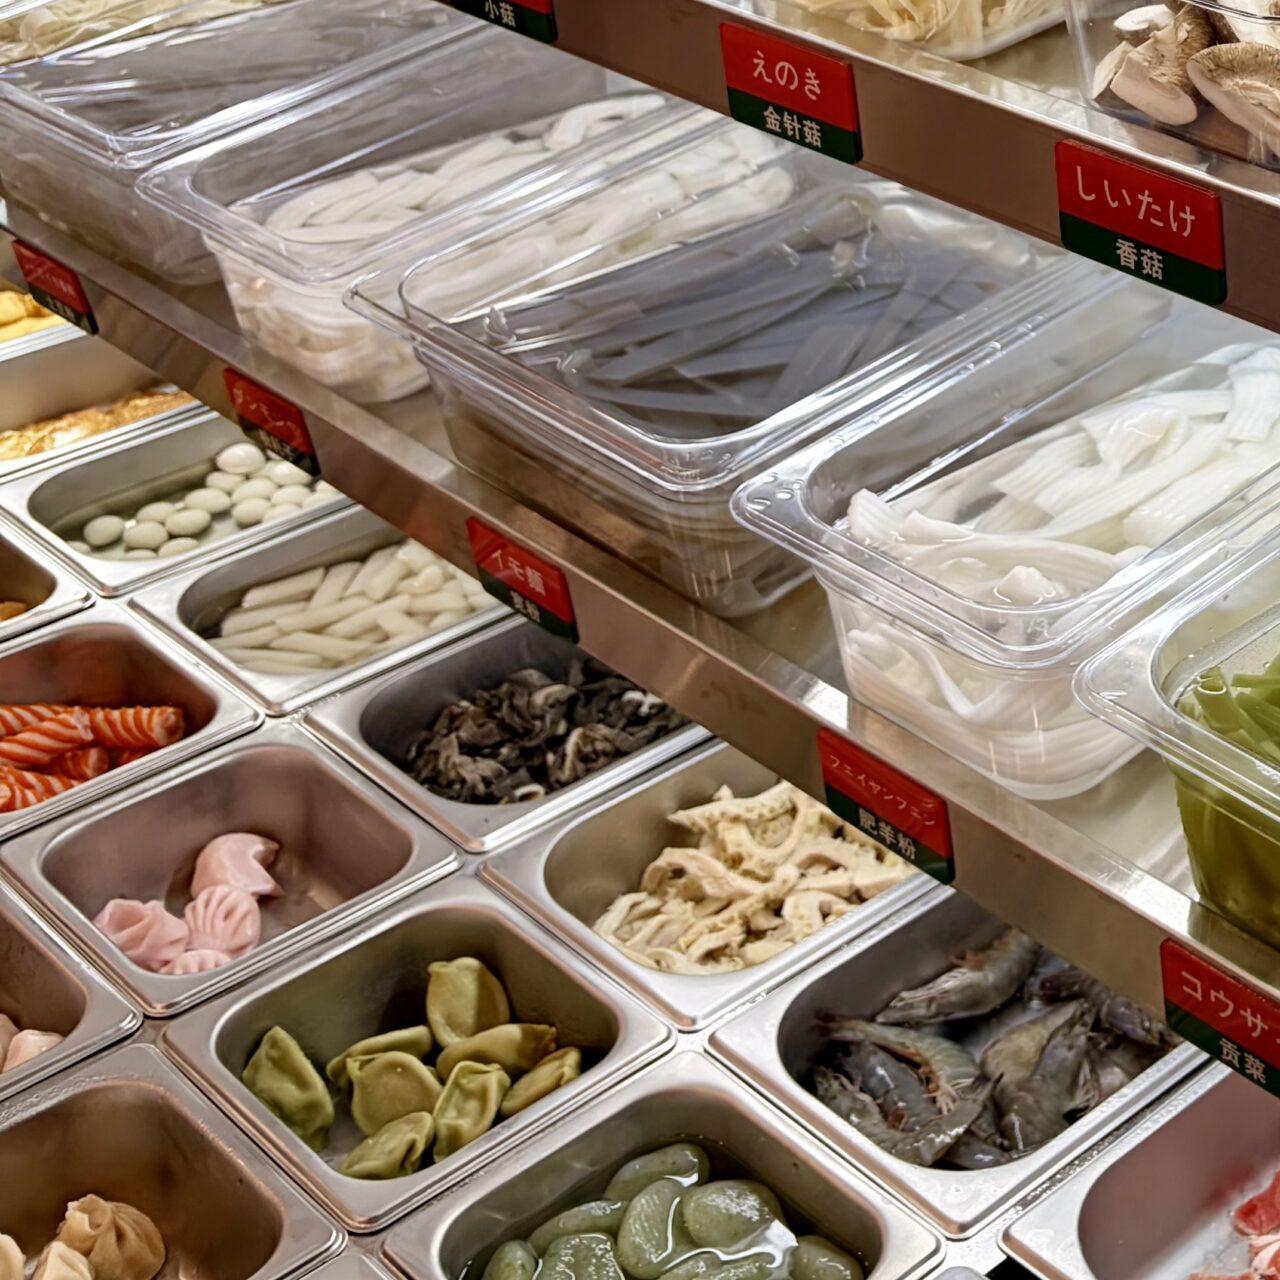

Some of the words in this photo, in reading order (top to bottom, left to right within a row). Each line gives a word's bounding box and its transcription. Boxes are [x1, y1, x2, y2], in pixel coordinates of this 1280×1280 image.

[752, 49, 822, 101] えのき
[763, 105, 822, 148] 金针菇
[1076, 165, 1196, 237] しいたけ
[1115, 238, 1164, 281] 香菇
